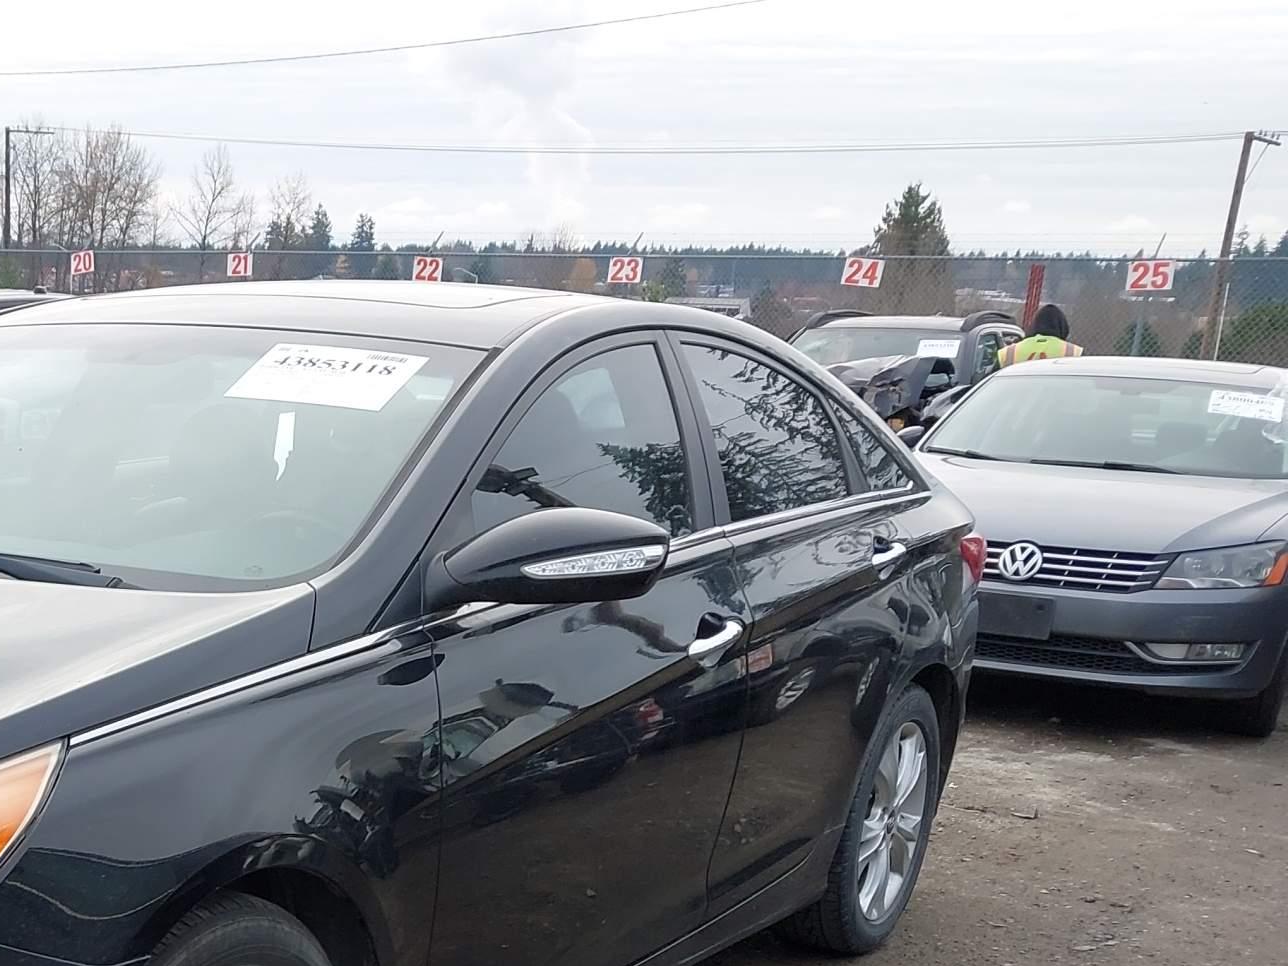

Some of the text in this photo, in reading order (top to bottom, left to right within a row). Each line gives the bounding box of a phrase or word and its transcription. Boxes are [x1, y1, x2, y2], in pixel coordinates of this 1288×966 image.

[73, 253, 92, 273] 20
[230, 254, 250, 276] 21
[414, 257, 440, 281] 22
[611, 258, 639, 282] 23
[844, 260, 881, 286] 24
[1128, 261, 1171, 290] 25
[273, 355, 398, 377] 43853118
